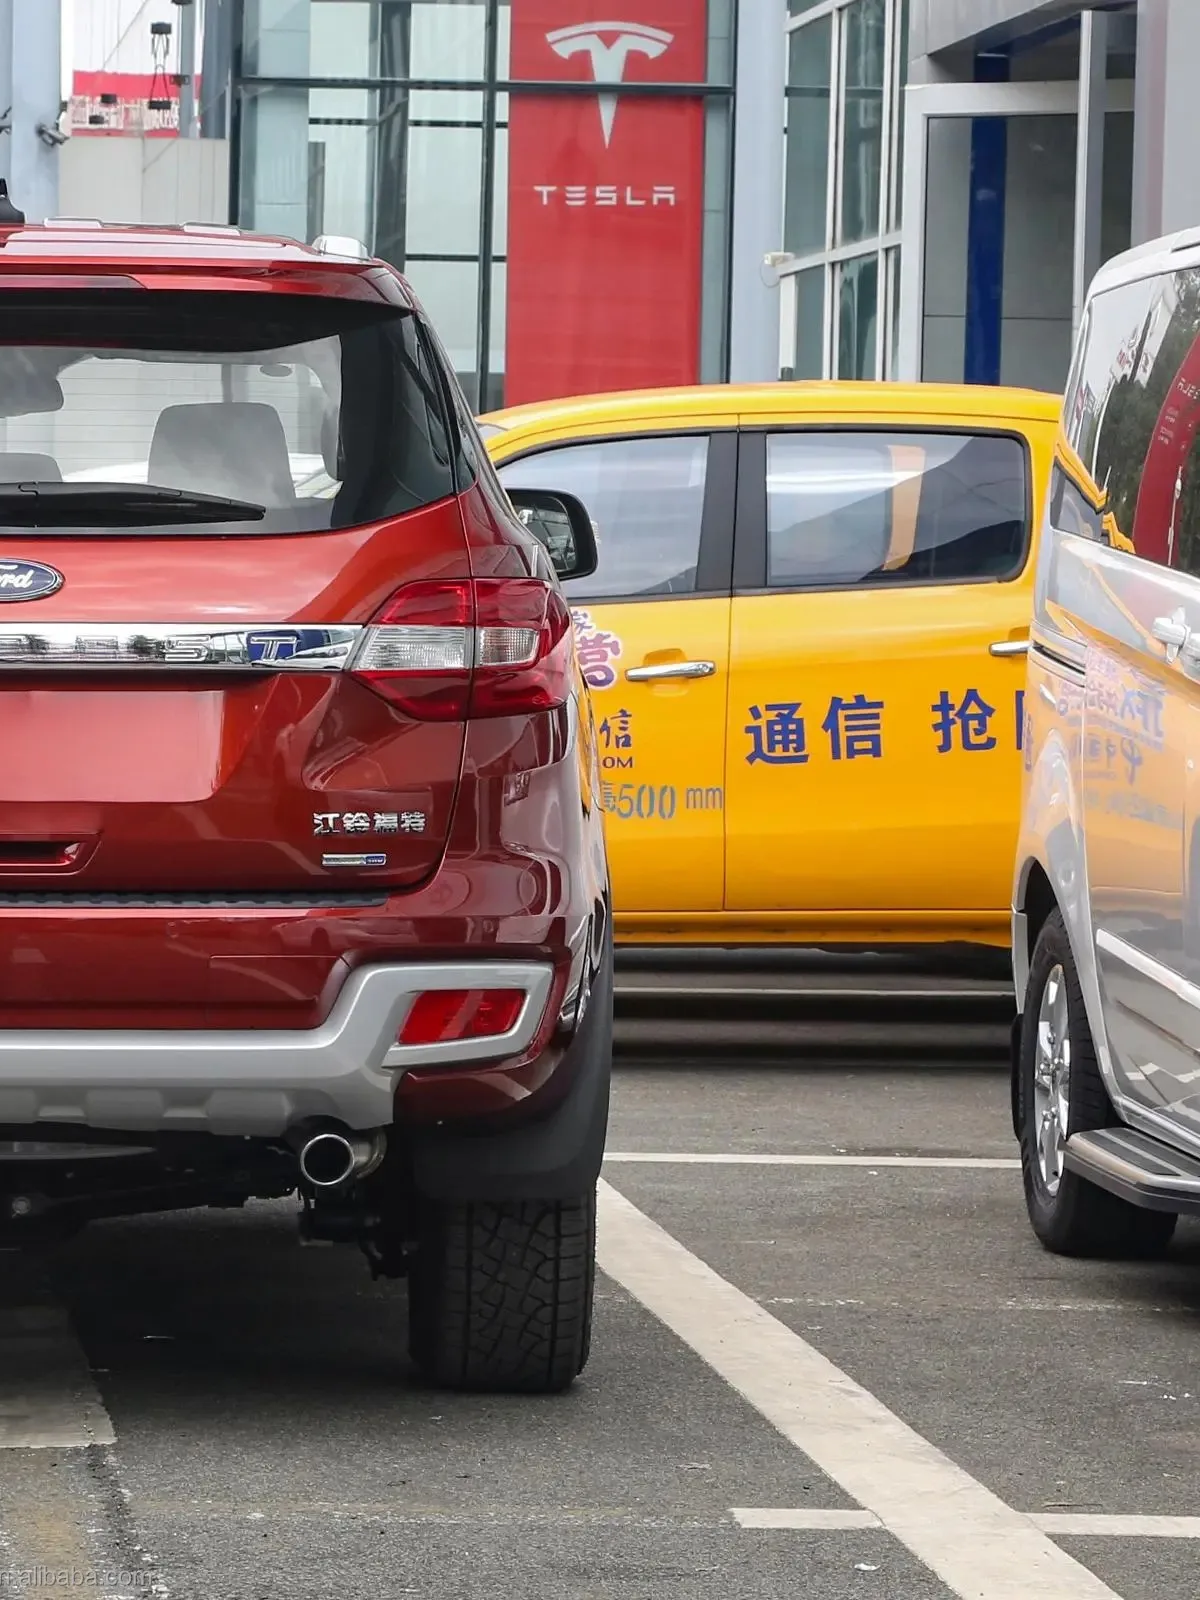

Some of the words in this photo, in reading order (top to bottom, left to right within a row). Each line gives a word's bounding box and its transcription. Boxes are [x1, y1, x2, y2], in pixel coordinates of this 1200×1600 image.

[533, 185, 676, 206] TESLA
[744, 694, 885, 766] 通信
[686, 786, 722, 810] mm
[313, 811, 426, 835] 江铃福特
